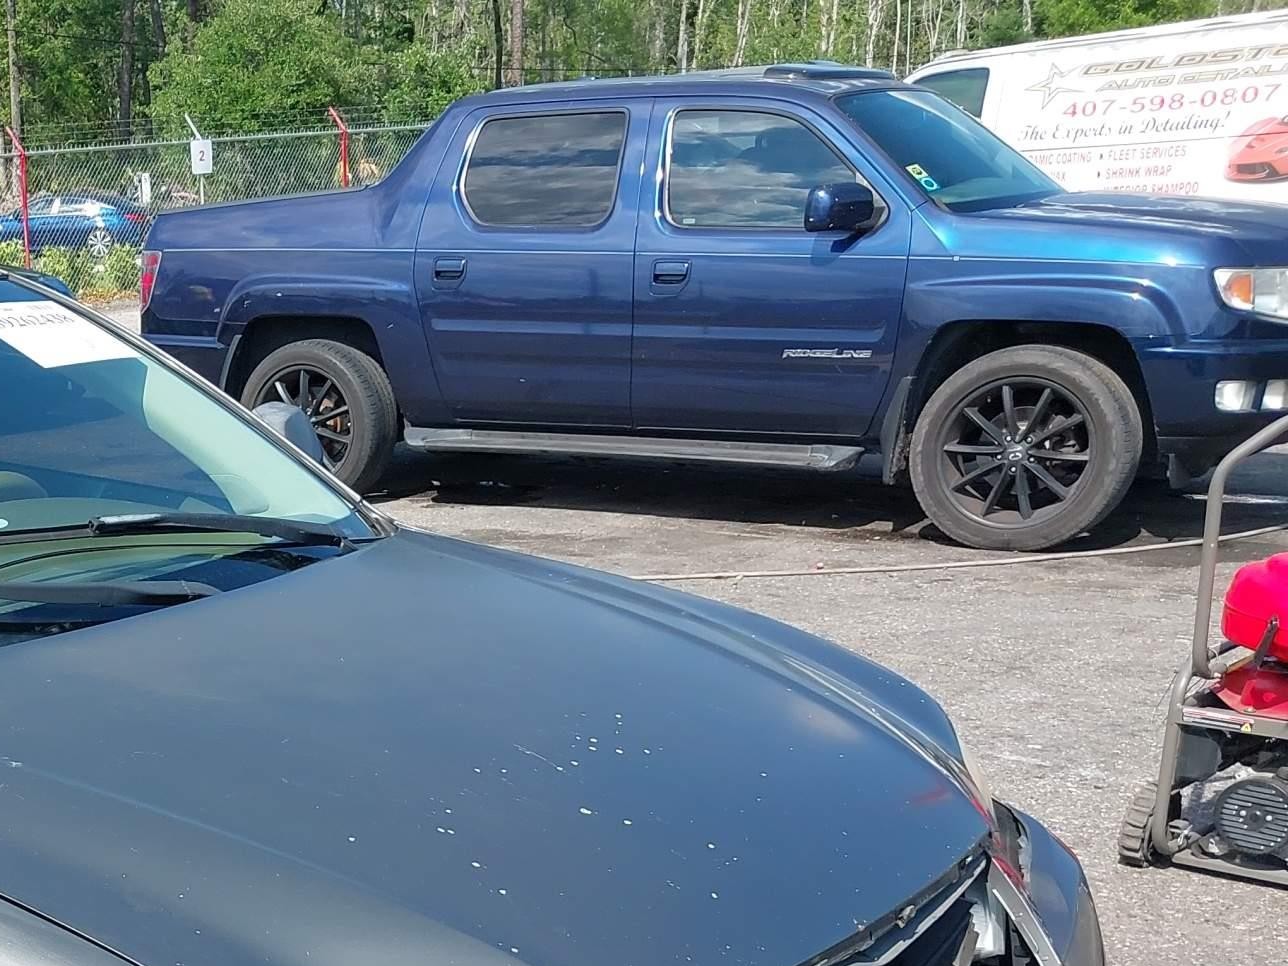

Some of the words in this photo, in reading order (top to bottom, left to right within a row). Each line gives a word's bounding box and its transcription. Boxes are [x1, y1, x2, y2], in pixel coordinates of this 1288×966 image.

[1095, 75, 1175, 92] AUTO
[1063, 82, 1282, 118] 407-598-0807
[1020, 124, 1046, 141] The
[1053, 122, 1112, 144] Experts
[1118, 121, 1133, 135] in
[1139, 110, 1231, 134] Detailing!
[198, 150, 206, 162] 2
[1057, 151, 1093, 164] COATING
[1108, 148, 1137, 161] FLEET
[1140, 145, 1188, 160] SERVICES
[1105, 167, 1142, 180] SHRINK
[1145, 164, 1173, 177] WRAP
[1152, 181, 1200, 195] SHAMPOO
